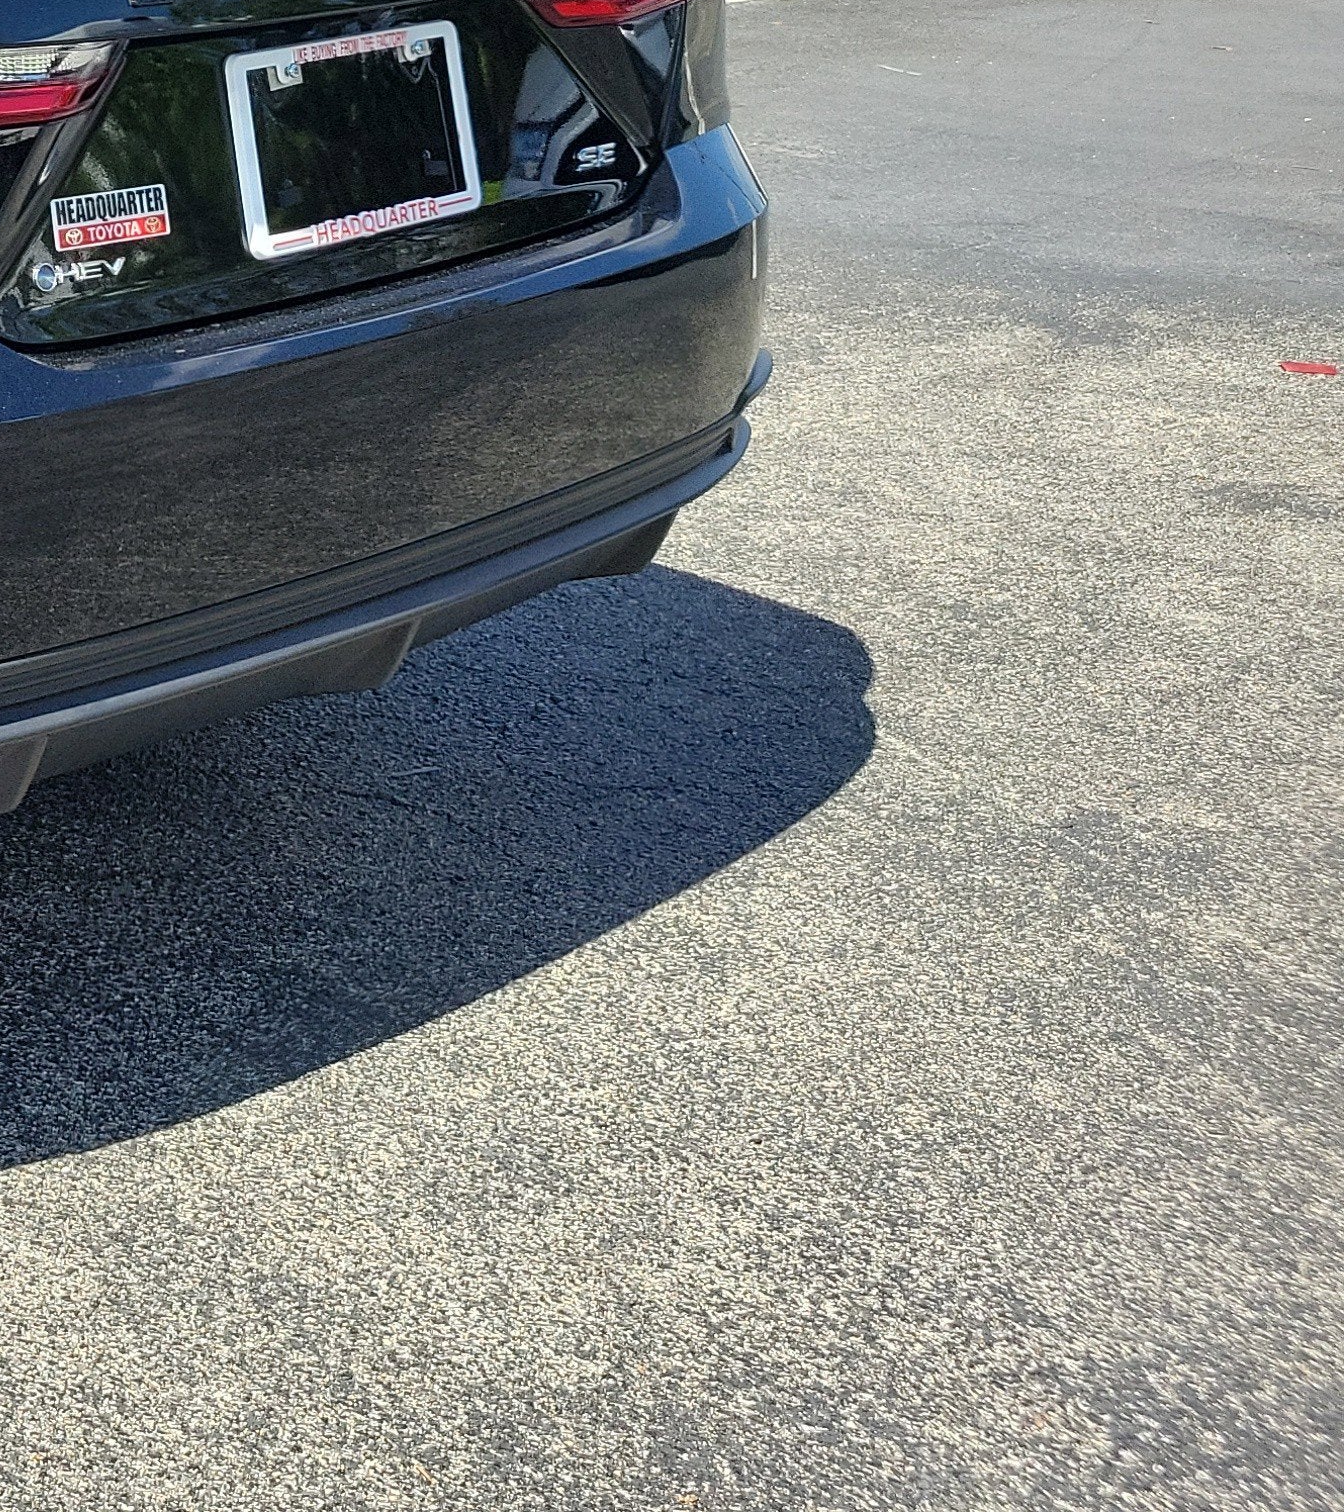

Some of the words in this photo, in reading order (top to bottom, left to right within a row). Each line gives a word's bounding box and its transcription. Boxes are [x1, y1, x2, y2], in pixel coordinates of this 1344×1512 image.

[575, 141, 617, 173] SE
[54, 186, 165, 227] HEADQUARTER
[316, 197, 439, 245] HEADQUARTER
[87, 220, 142, 242] TOYOTA
